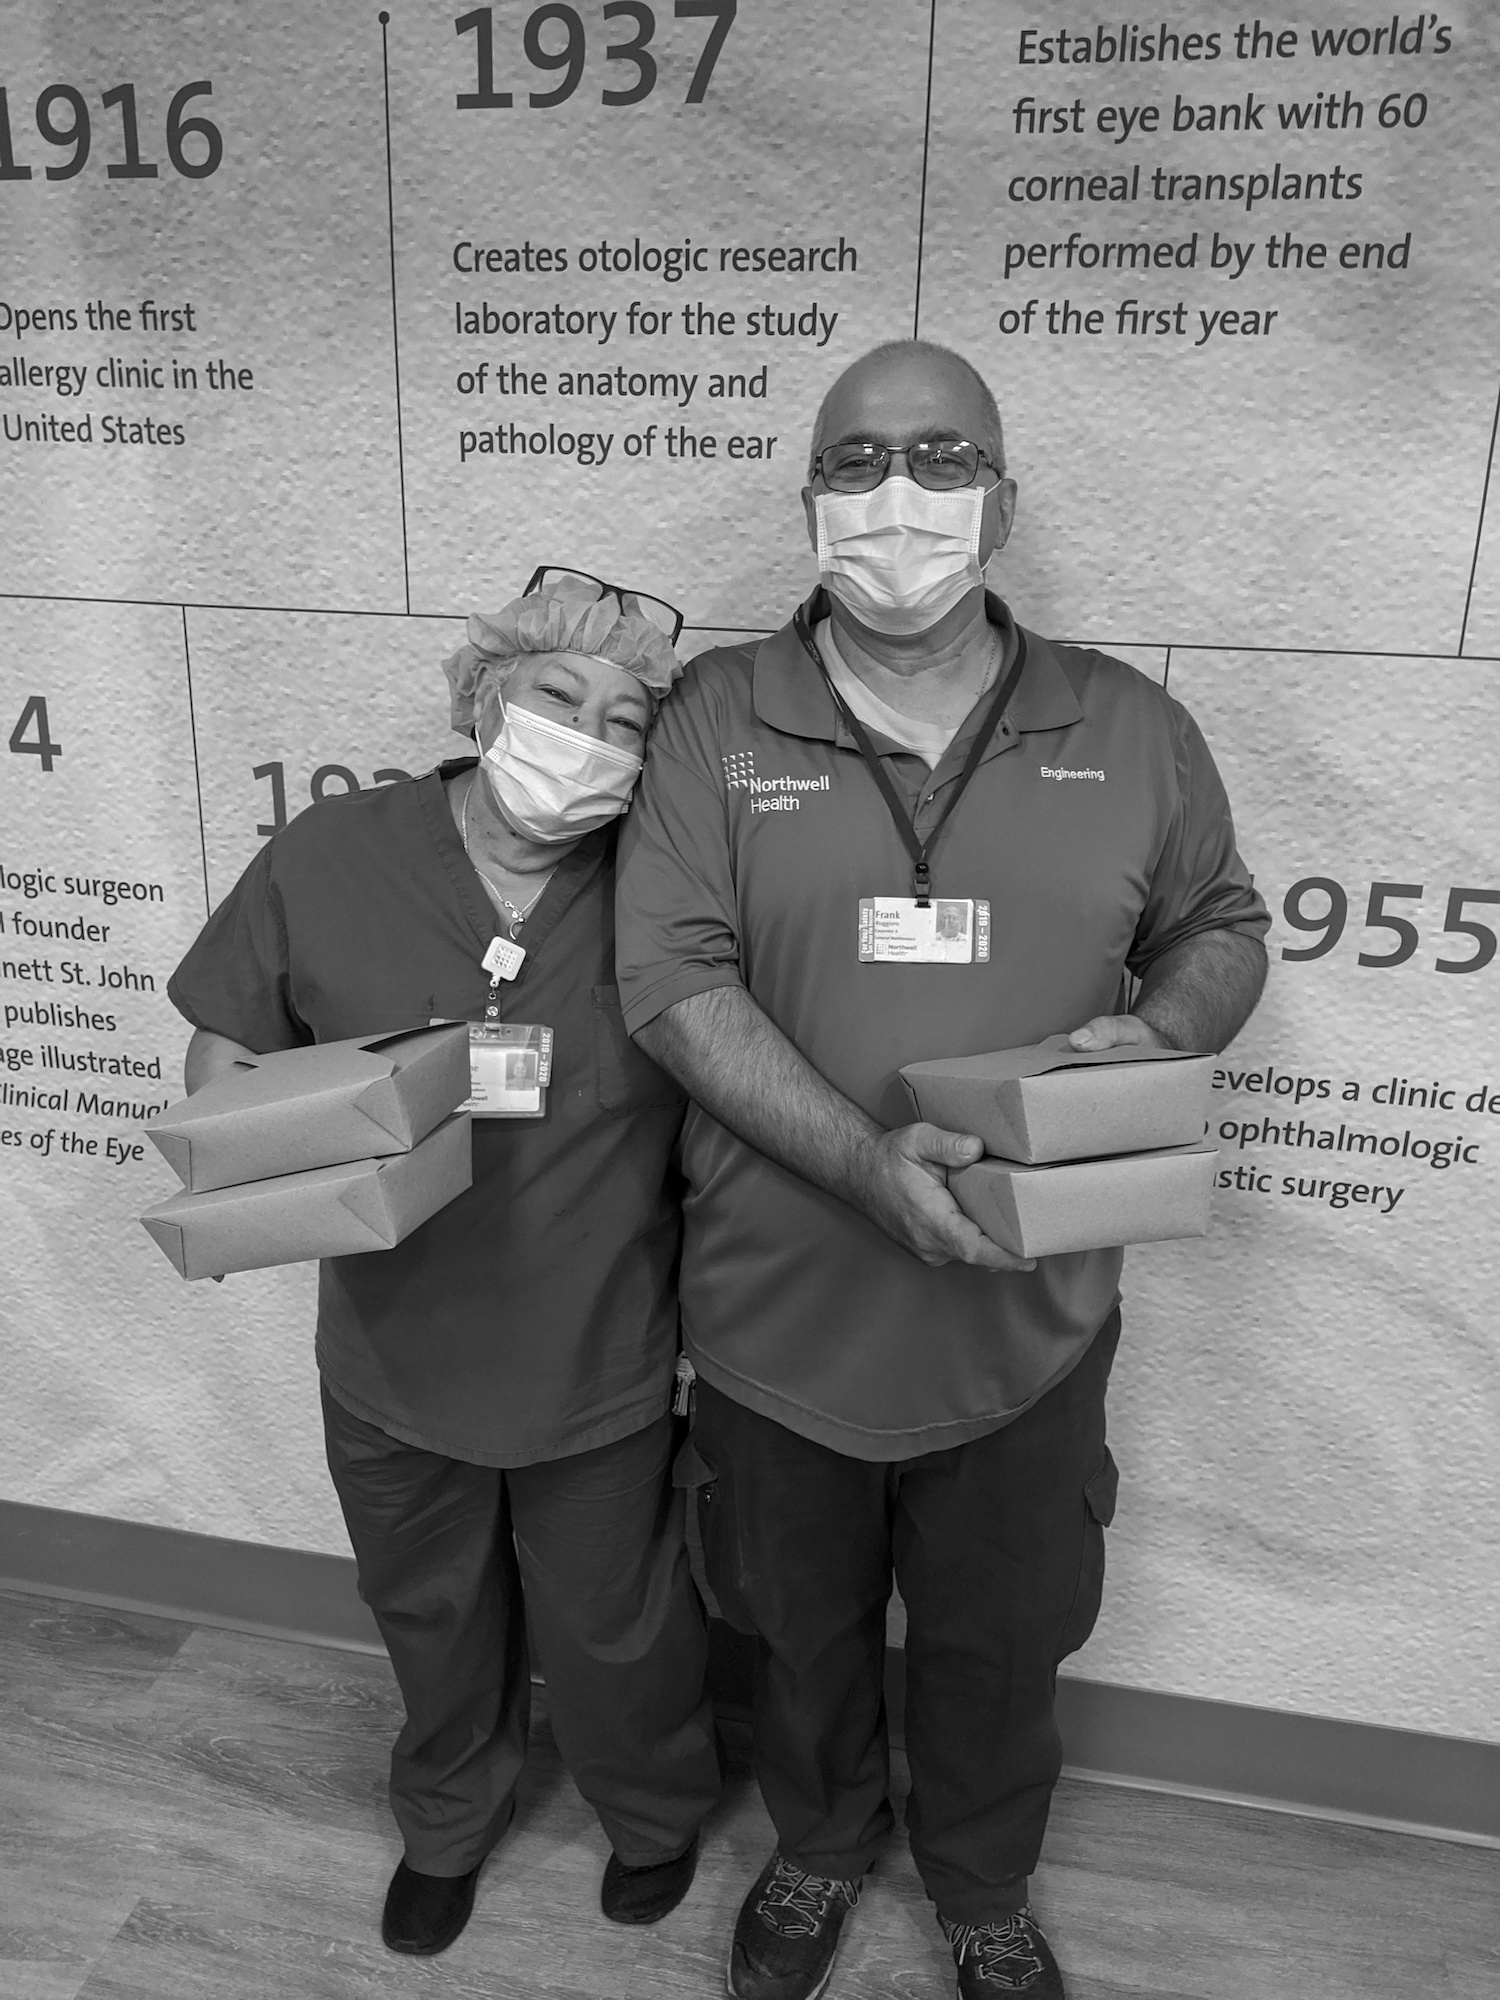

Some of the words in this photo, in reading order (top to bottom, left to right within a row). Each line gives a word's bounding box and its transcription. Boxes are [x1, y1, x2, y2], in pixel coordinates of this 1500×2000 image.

[453, 0, 738, 112] 1937
[1018, 23, 1222, 65] Establishes
[1234, 20, 1299, 59] the
[0, 81, 223, 180] 1916
[1012, 97, 1086, 135] first
[1097, 105, 1160, 145] eye
[1172, 93, 1265, 132] bank
[1277, 90, 1364, 130] with
[1377, 92, 1429, 128] 60
[1007, 165, 1140, 202] corneal
[1152, 163, 1363, 211] transplants
[453, 240, 568, 273] Creates
[578, 238, 709, 283] otologic
[719, 237, 858, 273] research
[1004, 233, 1199, 279] performed
[1211, 232, 1255, 280] by
[1266, 234, 1327, 270] the
[1339, 232, 1412, 270] end
[0, 302, 78, 340] Opens
[85, 300, 132, 331] the
[139, 300, 197, 332] first
[455, 301, 617, 344] laboratory
[626, 301, 674, 336] for
[682, 302, 735, 336] the
[746, 302, 839, 347] study
[998, 300, 1039, 335] of
[1046, 300, 1105, 335] the
[1116, 300, 1189, 336] first
[1195, 310, 1278, 346] year
[0, 357, 88, 397] allergy
[97, 358, 164, 389] clinic
[172, 359, 197, 389] in
[206, 360, 254, 390] the
[456, 363, 489, 395] of
[497, 364, 548, 396] the
[558, 366, 699, 407] anatomy
[708, 366, 768, 399] and
[3, 413, 93, 443] United
[101, 415, 186, 445] States
[460, 423, 614, 465] pathology
[623, 425, 657, 458] of
[665, 426, 718, 459] the
[727, 435, 778, 460] ear
[749, 775, 830, 794] Northwell
[1040, 766, 1105, 782] Engineering
[751, 796, 800, 814] Health
[64, 876, 164, 905] surgeon
[12, 911, 110, 942] founder
[876, 911, 901, 919] Frank
[1249, 875, 1500, 974] 955
[978, 935, 988, 957] 2020
[0, 959, 53, 983] nett
[60, 961, 92, 986] St.
[98, 964, 155, 992] John
[4, 1002, 117, 1031] publishes
[41, 1045, 162, 1080] illustrated
[0, 1084, 68, 1111] linical
[1342, 1082, 1361, 1101] a
[1372, 1077, 1456, 1110] clinic
[30, 1129, 56, 1157] of
[60, 1131, 98, 1156] the
[105, 1137, 145, 1165] Eye
[1219, 1117, 1480, 1169] ophthalmologic
[1213, 1166, 1273, 1193] stic
[1281, 1175, 1405, 1213] surgery
